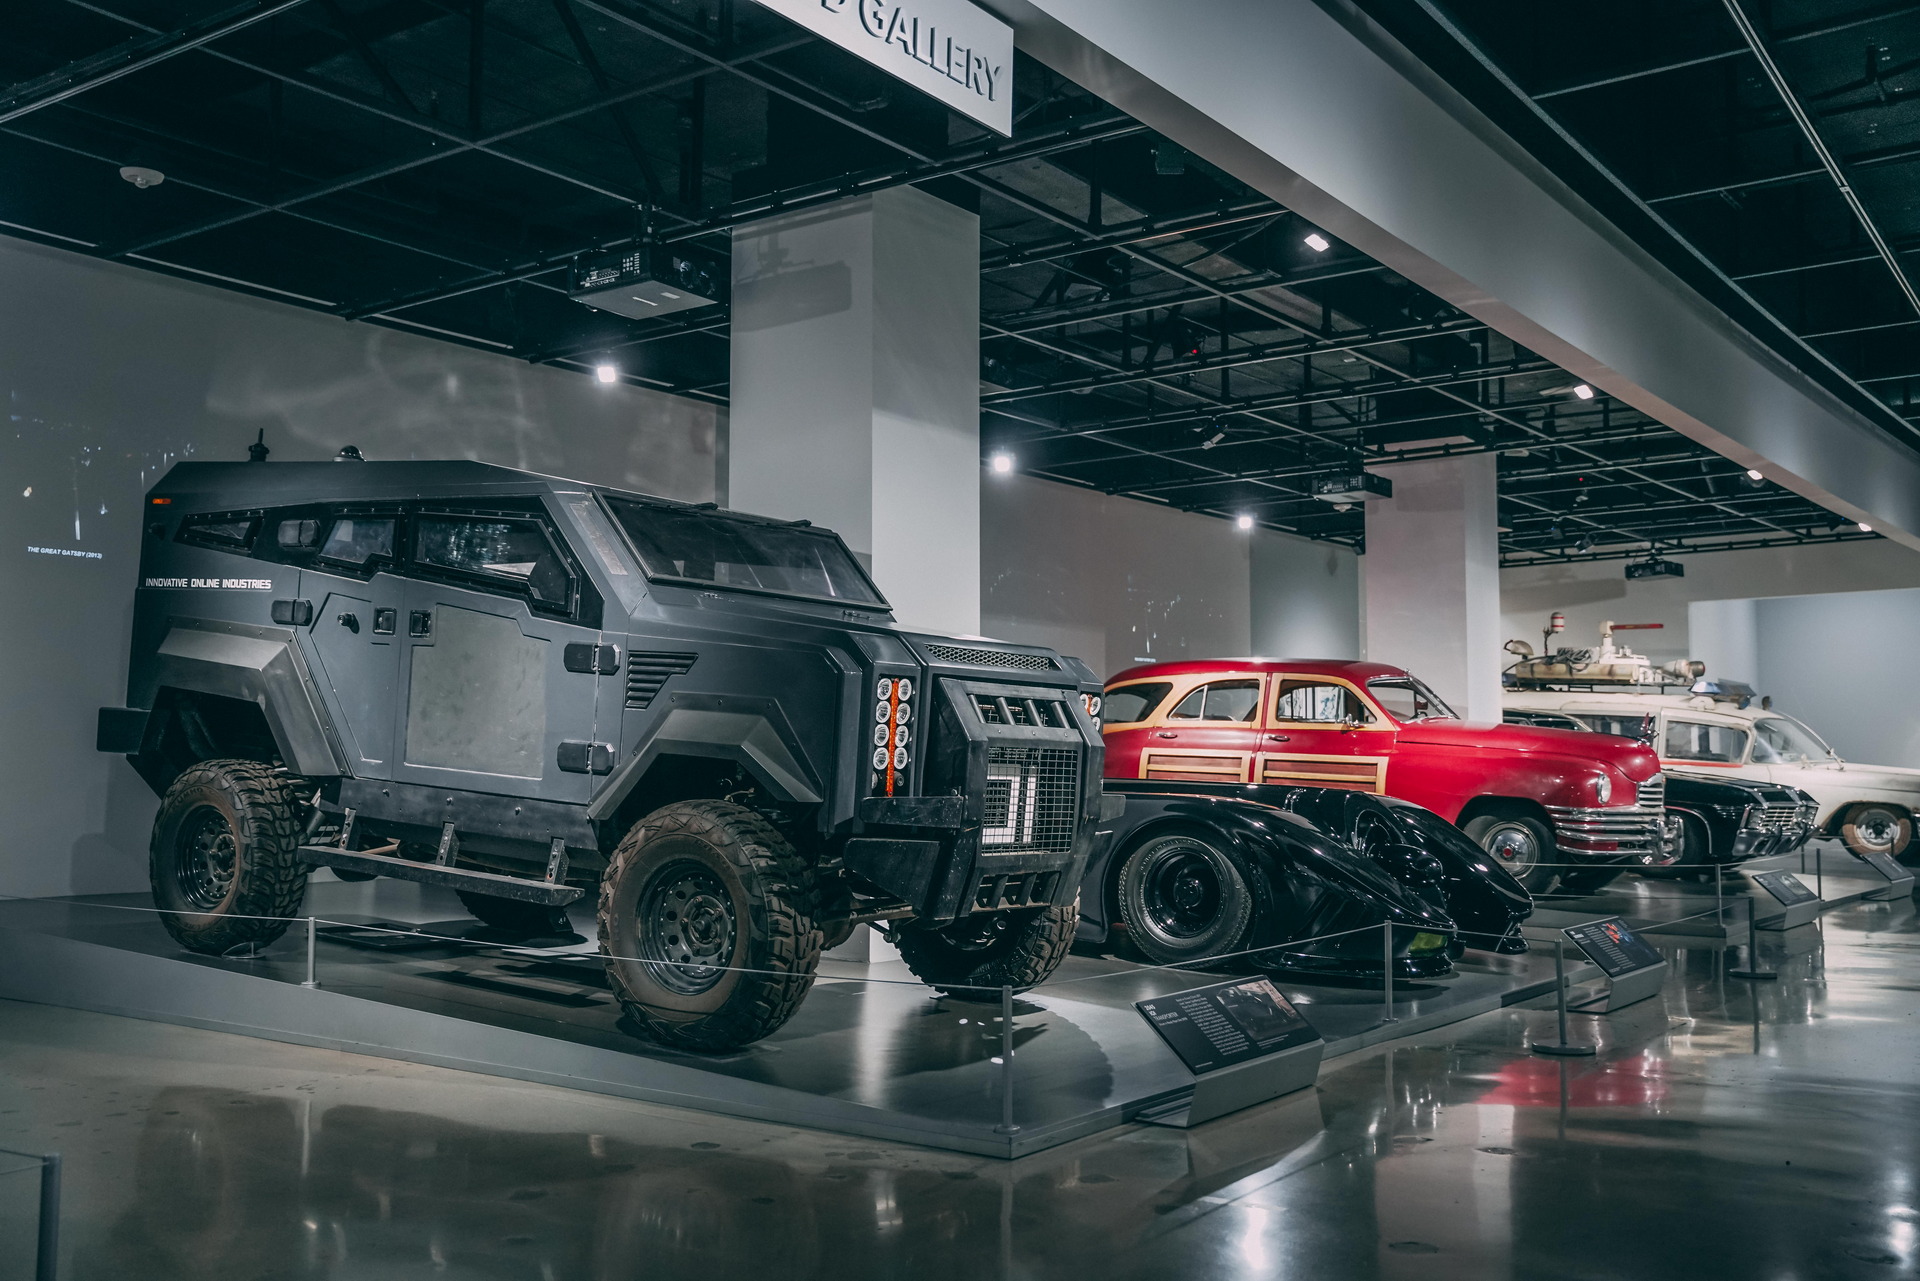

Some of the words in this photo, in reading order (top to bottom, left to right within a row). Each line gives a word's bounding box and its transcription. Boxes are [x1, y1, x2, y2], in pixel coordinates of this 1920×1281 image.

[858, 0, 1003, 101] GALLERY
[27, 545, 40, 553] THE
[40, 547, 61, 555] GREAT
[61, 549, 86, 557] GATSBY
[145, 578, 188, 588] INNOVATIVE
[190, 578, 220, 588] ONLINE
[222, 578, 272, 589] INDUSTRIES
